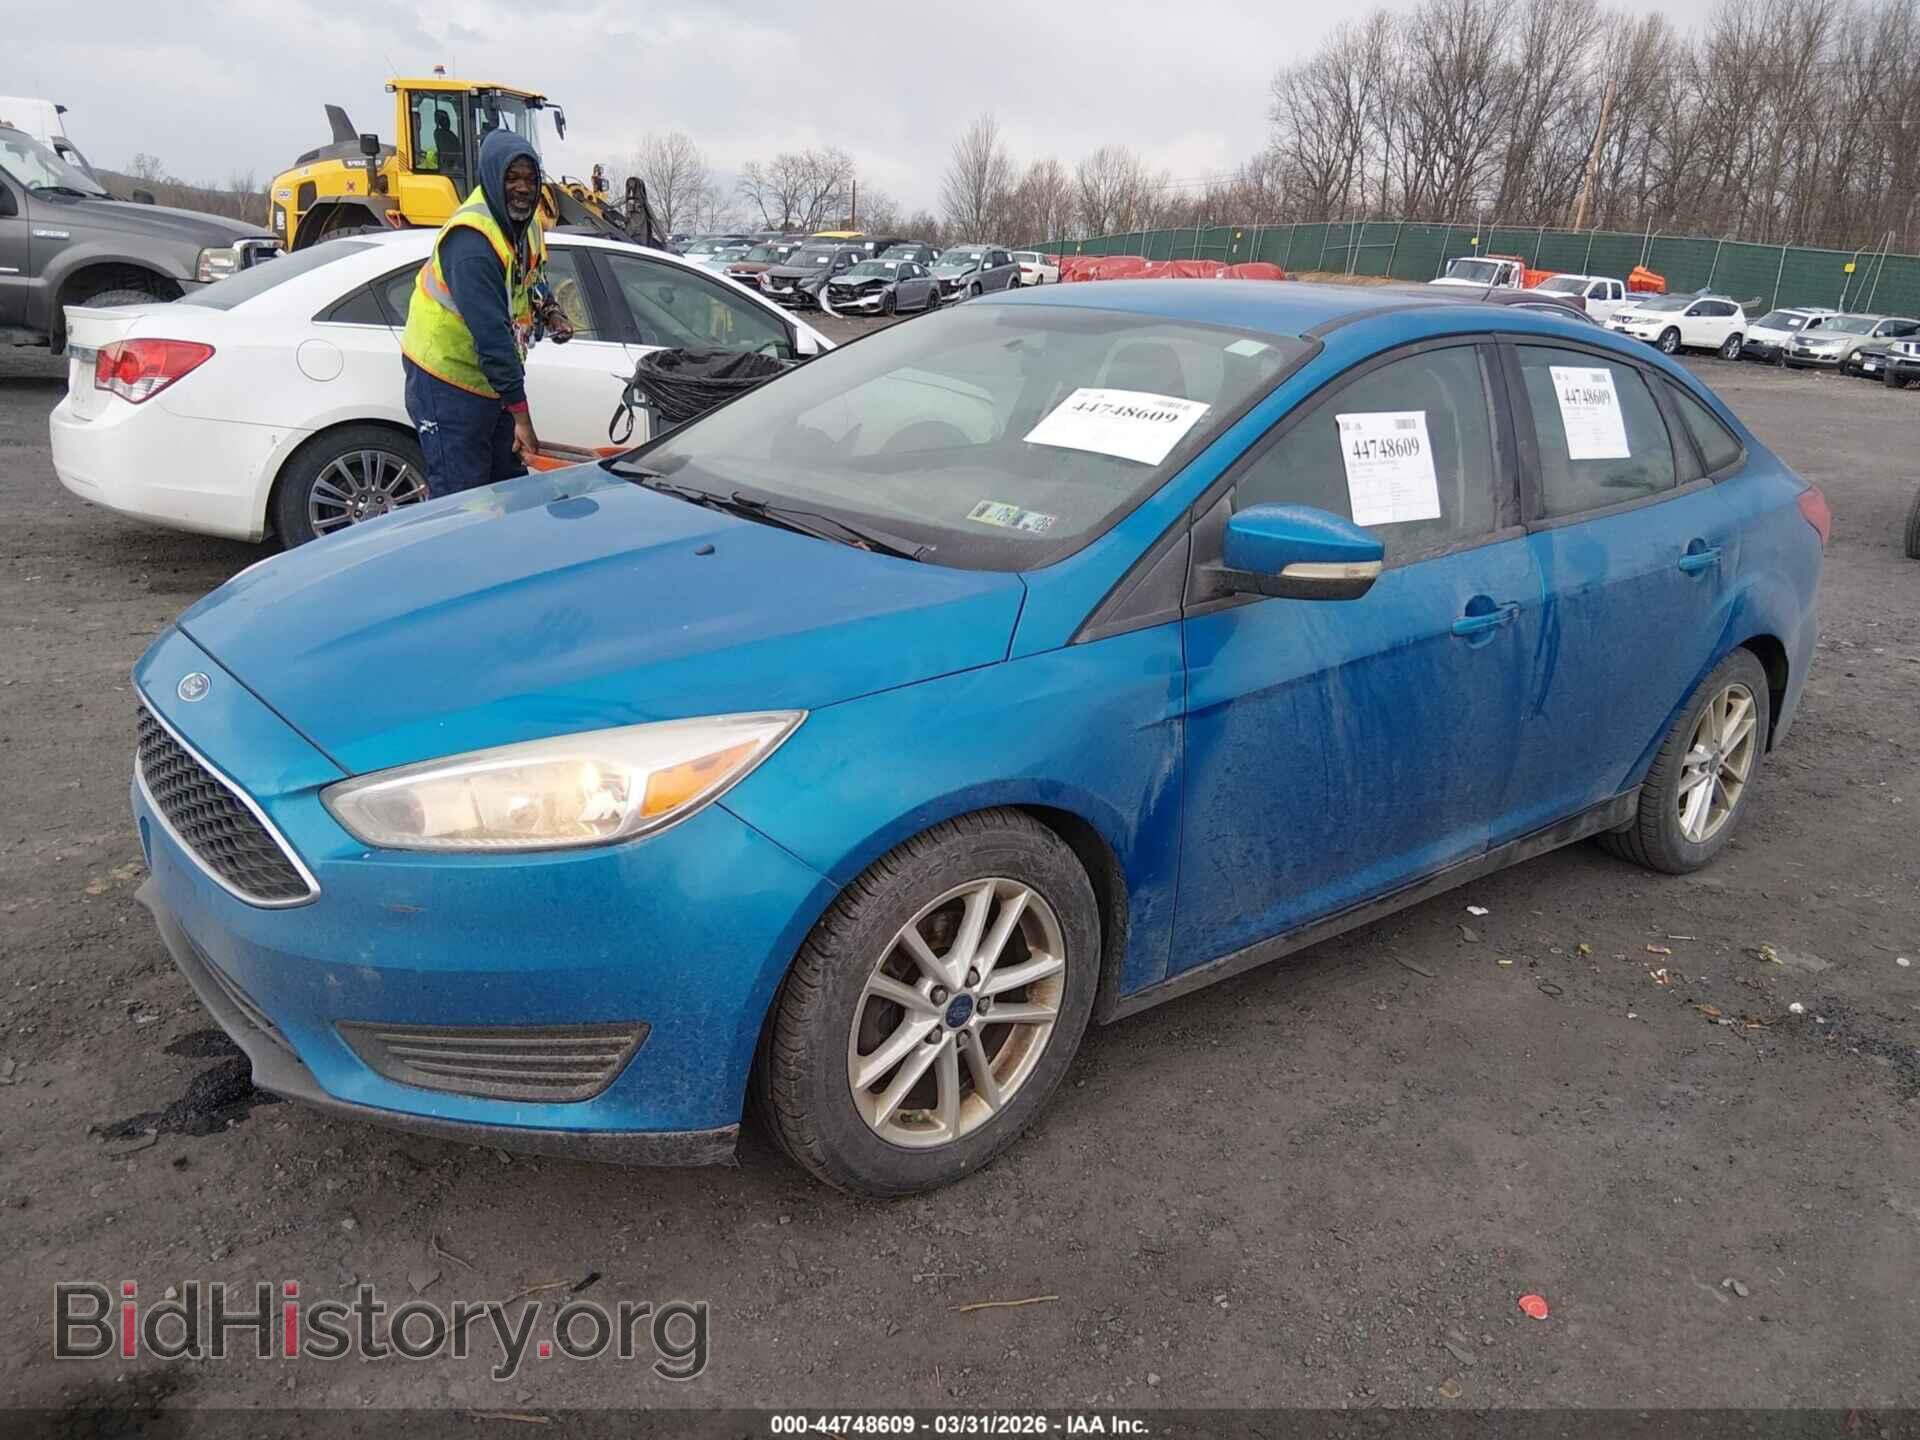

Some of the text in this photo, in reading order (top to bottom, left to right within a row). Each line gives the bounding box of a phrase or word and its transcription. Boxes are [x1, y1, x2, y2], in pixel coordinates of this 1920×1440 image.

[1562, 387, 1612, 405] 44748609
[1072, 401, 1179, 424] 44748609
[1352, 437, 1420, 459] 44748609
